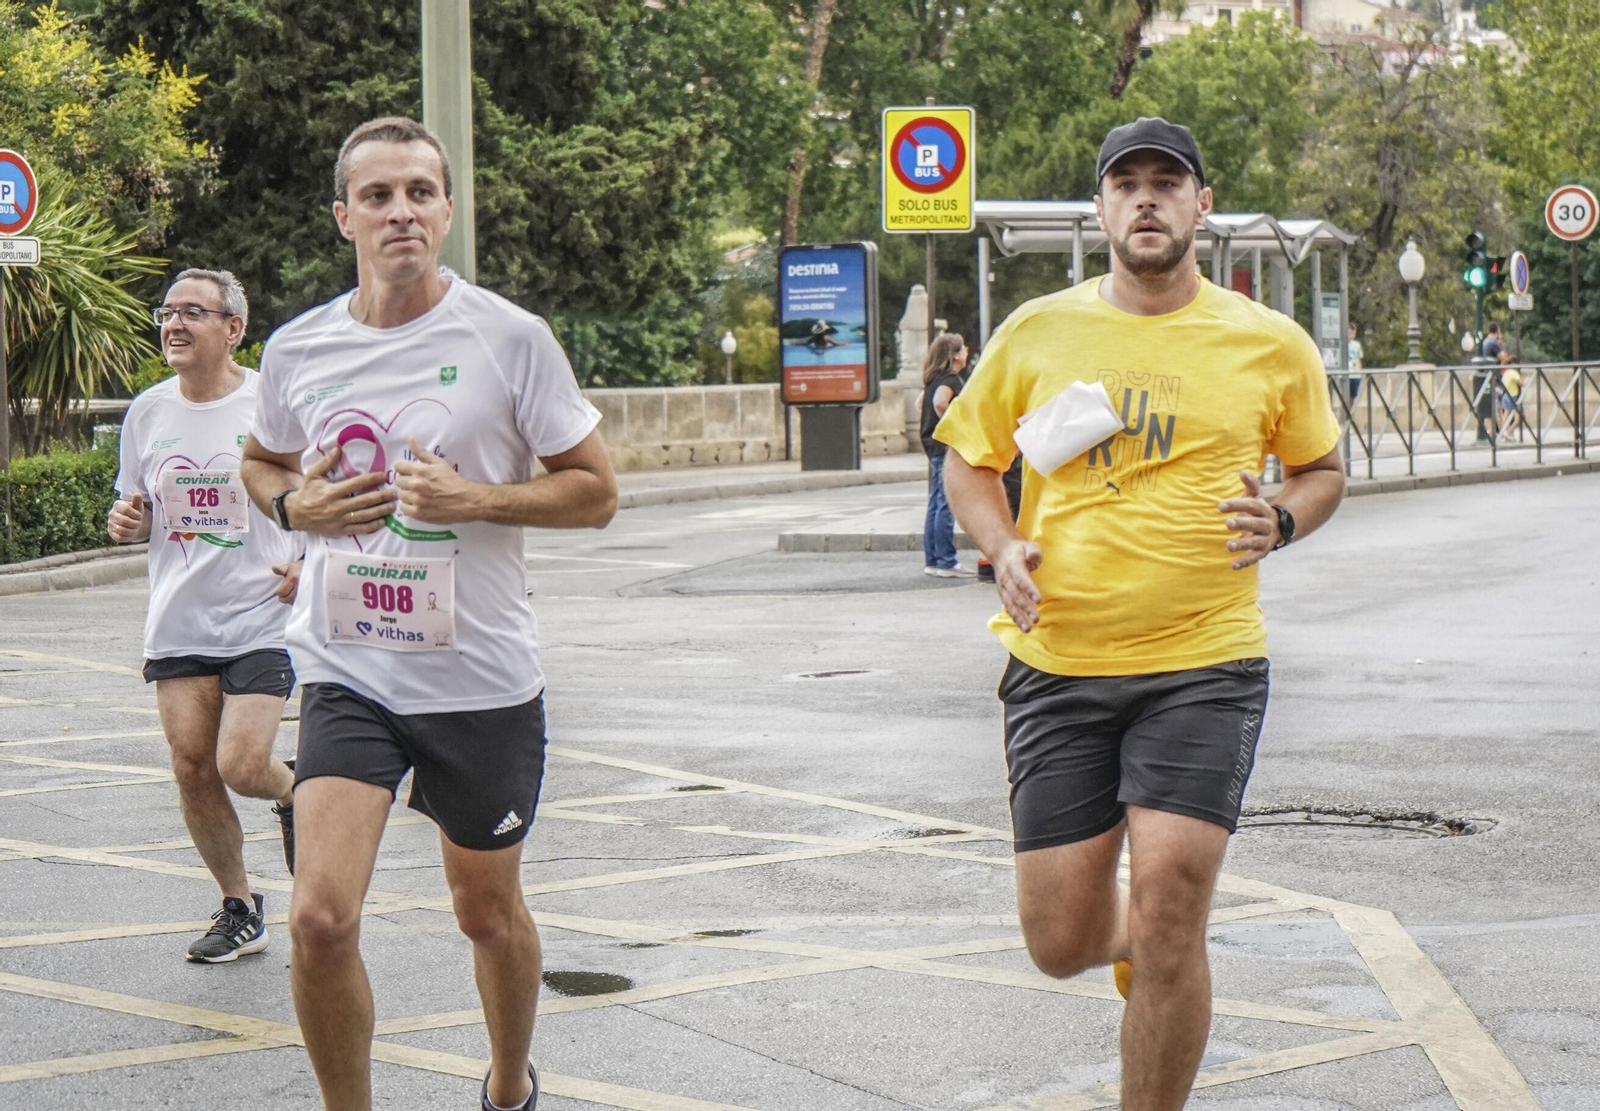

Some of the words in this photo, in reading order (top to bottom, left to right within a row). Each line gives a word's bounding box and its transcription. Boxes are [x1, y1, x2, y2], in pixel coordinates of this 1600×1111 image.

[923, 150, 932, 162] P
[915, 167, 940, 177] BUS
[2, 184, 11, 200] P
[898, 199, 930, 211] SOLO
[934, 199, 958, 210] BUS
[1559, 205, 1586, 220] 30
[890, 215, 967, 224] METROPOLITANO
[3, 241, 14, 250] BUS
[176, 477, 230, 485] COVIRAN
[187, 487, 219, 507] 126
[195, 517, 229, 526] vithas
[347, 564, 428, 581] COVIRAN
[362, 581, 414, 614] 908
[376, 626, 425, 642] vithas
